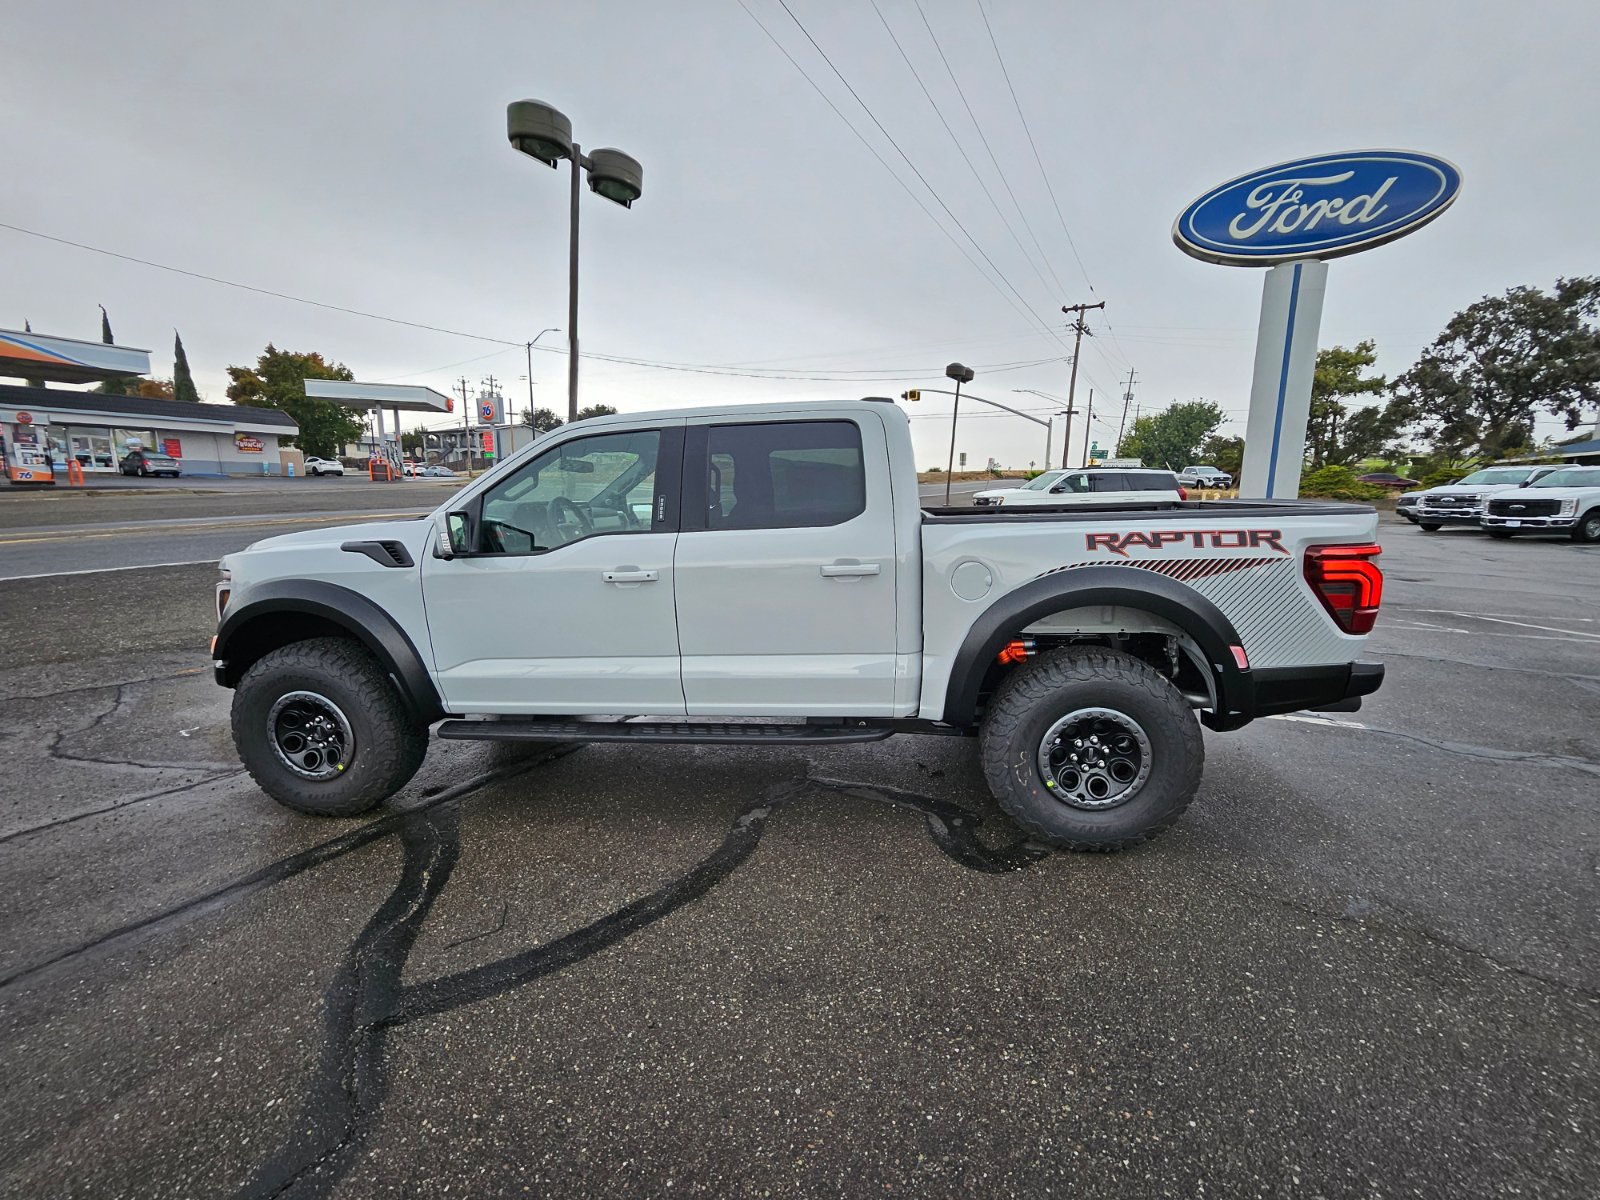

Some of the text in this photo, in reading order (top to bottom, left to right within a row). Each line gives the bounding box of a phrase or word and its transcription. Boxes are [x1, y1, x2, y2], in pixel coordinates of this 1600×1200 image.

[1228, 170, 1399, 240] Ford
[482, 405, 492, 416] 76
[17, 471, 33, 479] 76
[1085, 529, 1291, 558] RAPTOR
